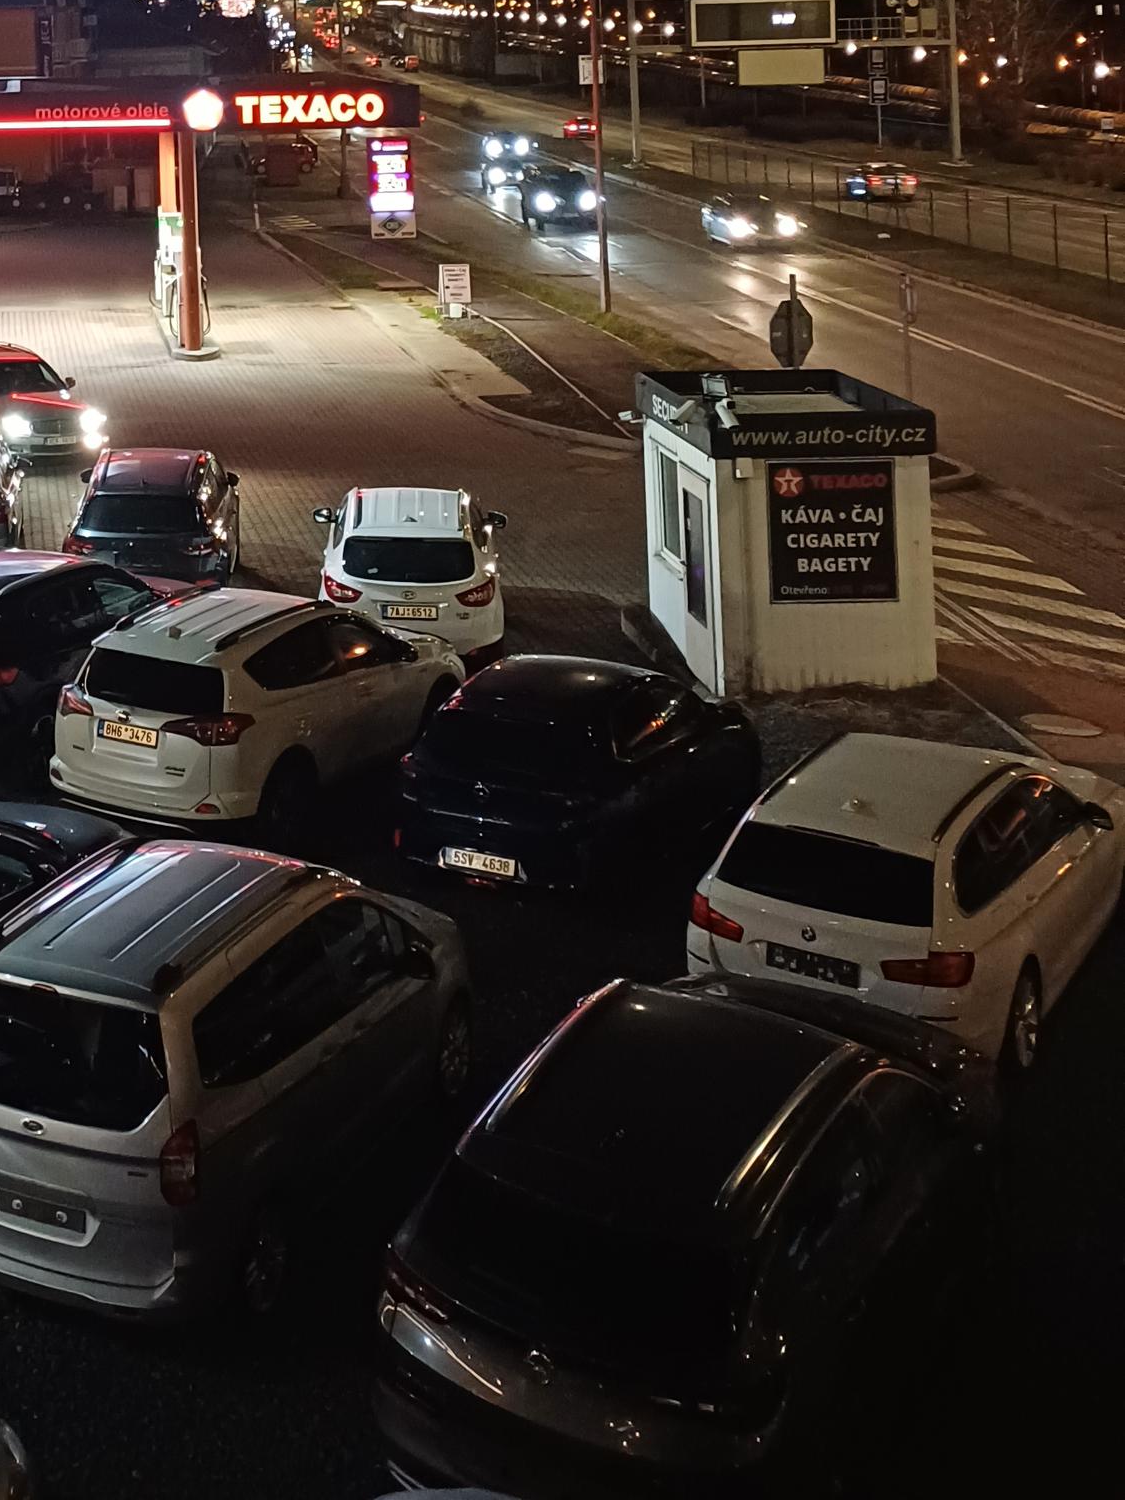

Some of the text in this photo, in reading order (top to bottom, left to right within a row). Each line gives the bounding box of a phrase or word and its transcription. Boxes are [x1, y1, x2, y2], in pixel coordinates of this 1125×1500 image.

[35, 103, 121, 119] motorové
[235, 93, 385, 125] TEXACO
[732, 425, 926, 448] www.auto-city.cz
[810, 473, 888, 489] TEXACO
[780, 503, 884, 526] KÁVA ČAJ
[786, 531, 881, 549] CIGARETY
[797, 556, 872, 573] BAGETY
